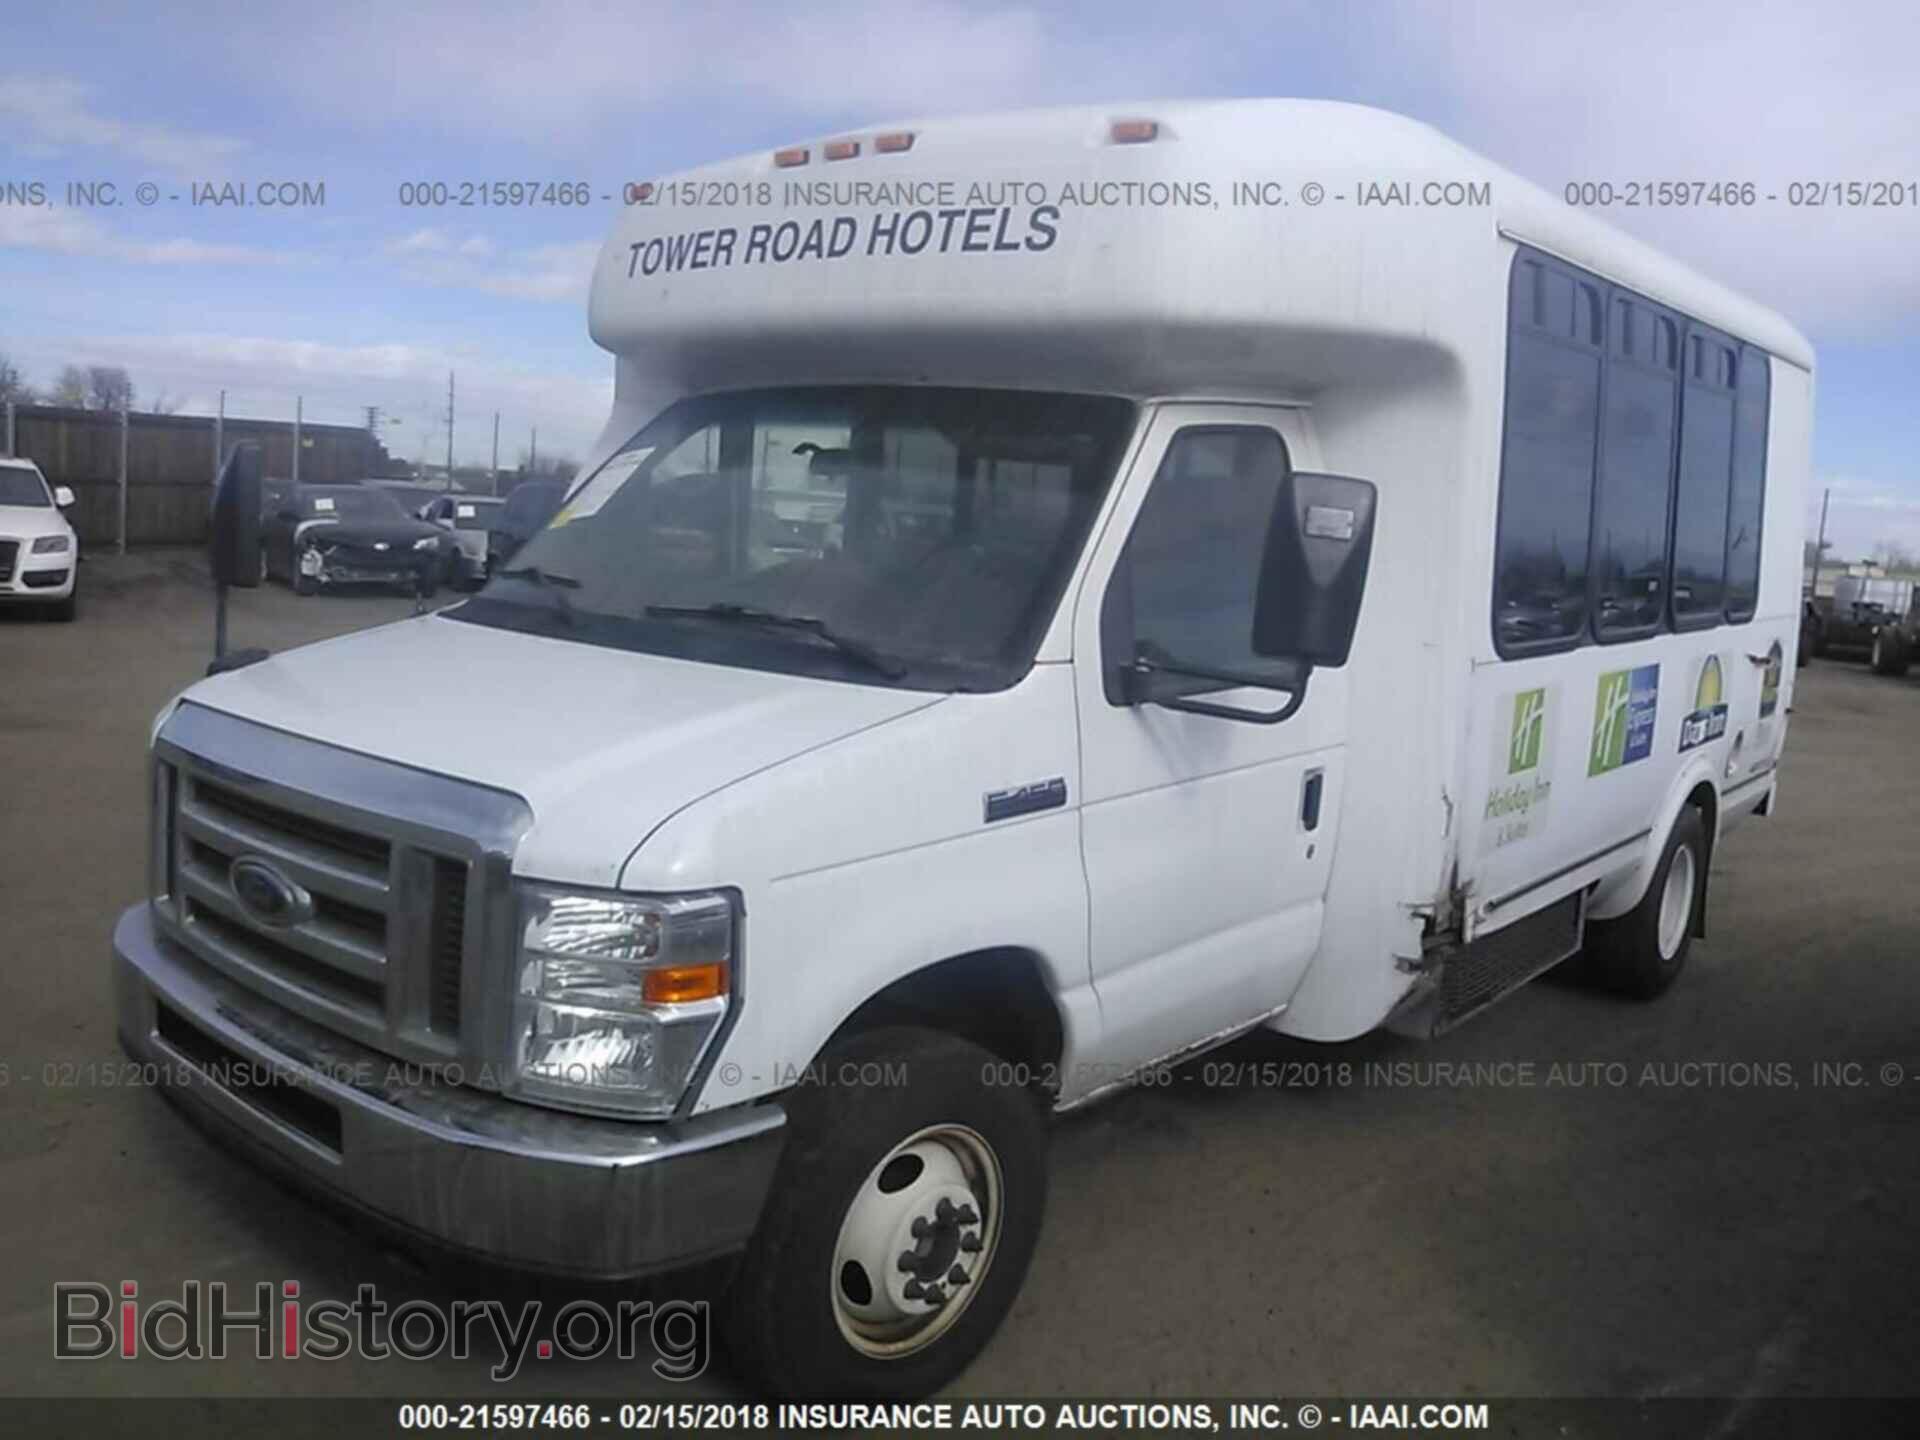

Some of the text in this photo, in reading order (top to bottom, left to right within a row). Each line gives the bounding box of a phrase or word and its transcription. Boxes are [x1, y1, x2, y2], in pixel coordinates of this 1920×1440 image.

[627, 205, 1061, 278] TOWER ROAD HOTELS
